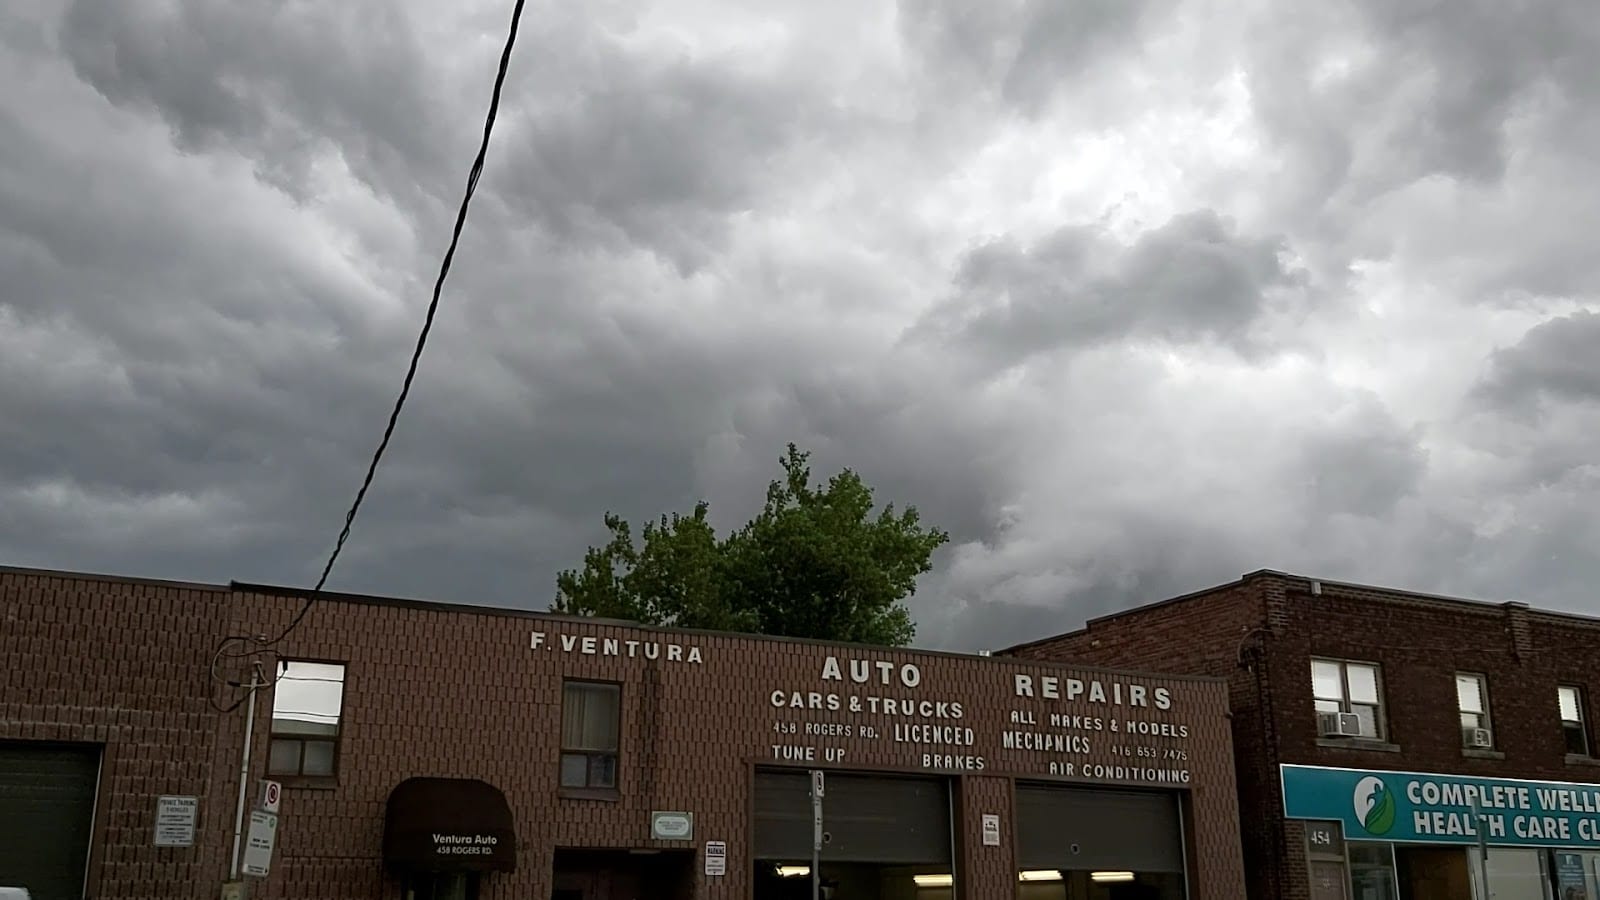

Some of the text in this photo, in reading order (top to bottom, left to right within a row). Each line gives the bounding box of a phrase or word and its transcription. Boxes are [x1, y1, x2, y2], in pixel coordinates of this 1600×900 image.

[530, 631, 1172, 710] F. VENTURA AUTO REPAIRS
[770, 690, 964, 718] CARS & TRUCKS
[773, 722, 879, 738] 458 ROGERS RD.
[1010, 710, 1188, 738] ALL MAKES & MODELS
[895, 723, 1090, 754] LICENCED MECHANICS
[772, 745, 846, 763] TUNE UP
[923, 754, 985, 770] BRAKES
[1112, 745, 1188, 761] 416 653 7475
[1050, 761, 1190, 783] AIR CONDITIONING
[1407, 781, 1531, 810] COMPLETE
[1311, 830, 1330, 845] 454
[1513, 815, 1571, 840] CARE
[432, 832, 498, 845] Ventura Auto
[437, 846, 451, 854] 458
[452, 846, 481, 855] ROGERS
